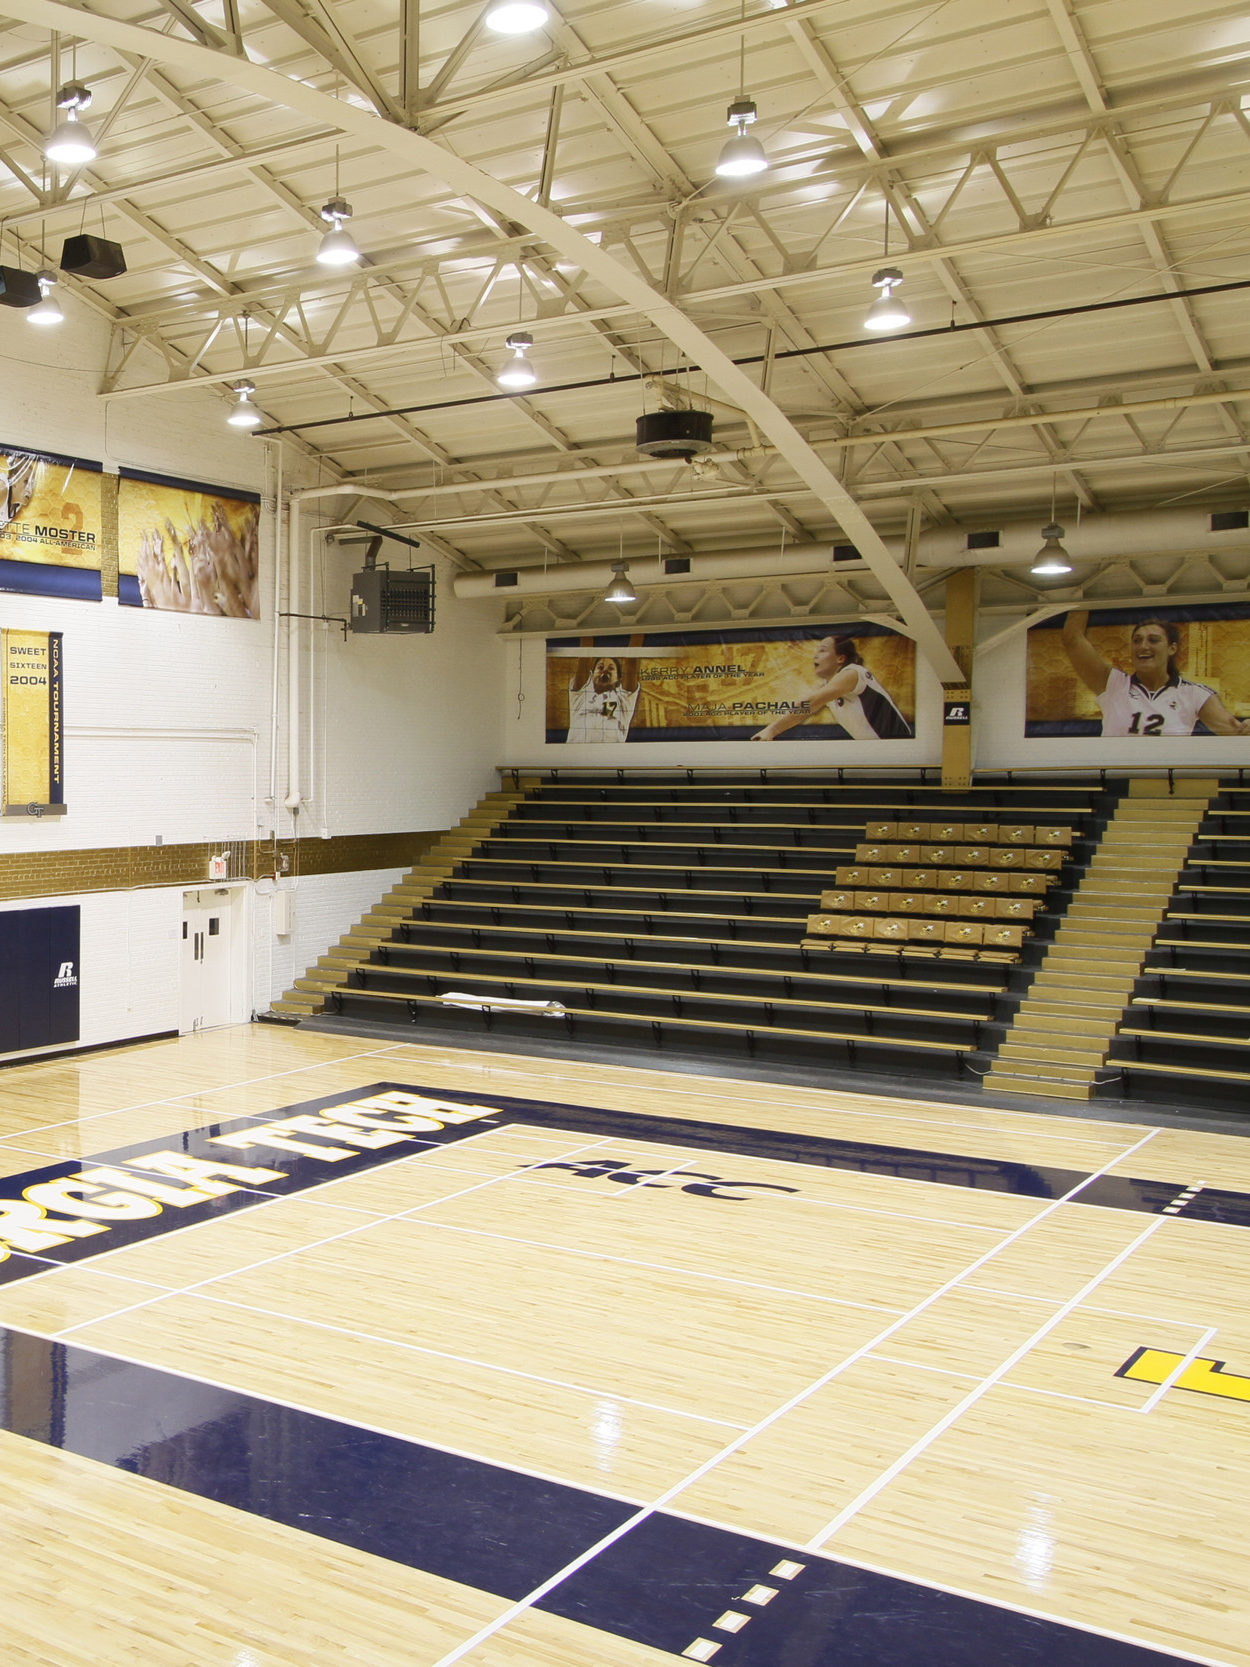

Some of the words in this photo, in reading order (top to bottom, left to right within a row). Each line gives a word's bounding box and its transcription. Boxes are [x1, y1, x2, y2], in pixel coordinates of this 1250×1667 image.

[15, 534, 38, 543] 2004
[39, 538, 96, 551] ALL-AMERICAN
[34, 524, 96, 544] MOSTER
[9, 646, 47, 656] SWEET
[9, 662, 47, 670] SIXTEEN
[640, 666, 688, 675] KERRY
[692, 664, 746, 674] ANNEL
[9, 675, 47, 685] 2004
[603, 701, 618, 719] 17
[687, 702, 727, 711] MAJA
[731, 700, 811, 710] PACHALE
[1128, 711, 1165, 736] 12
[206, 1091, 504, 1162] TECH
[517, 1159, 801, 1201] ACC
